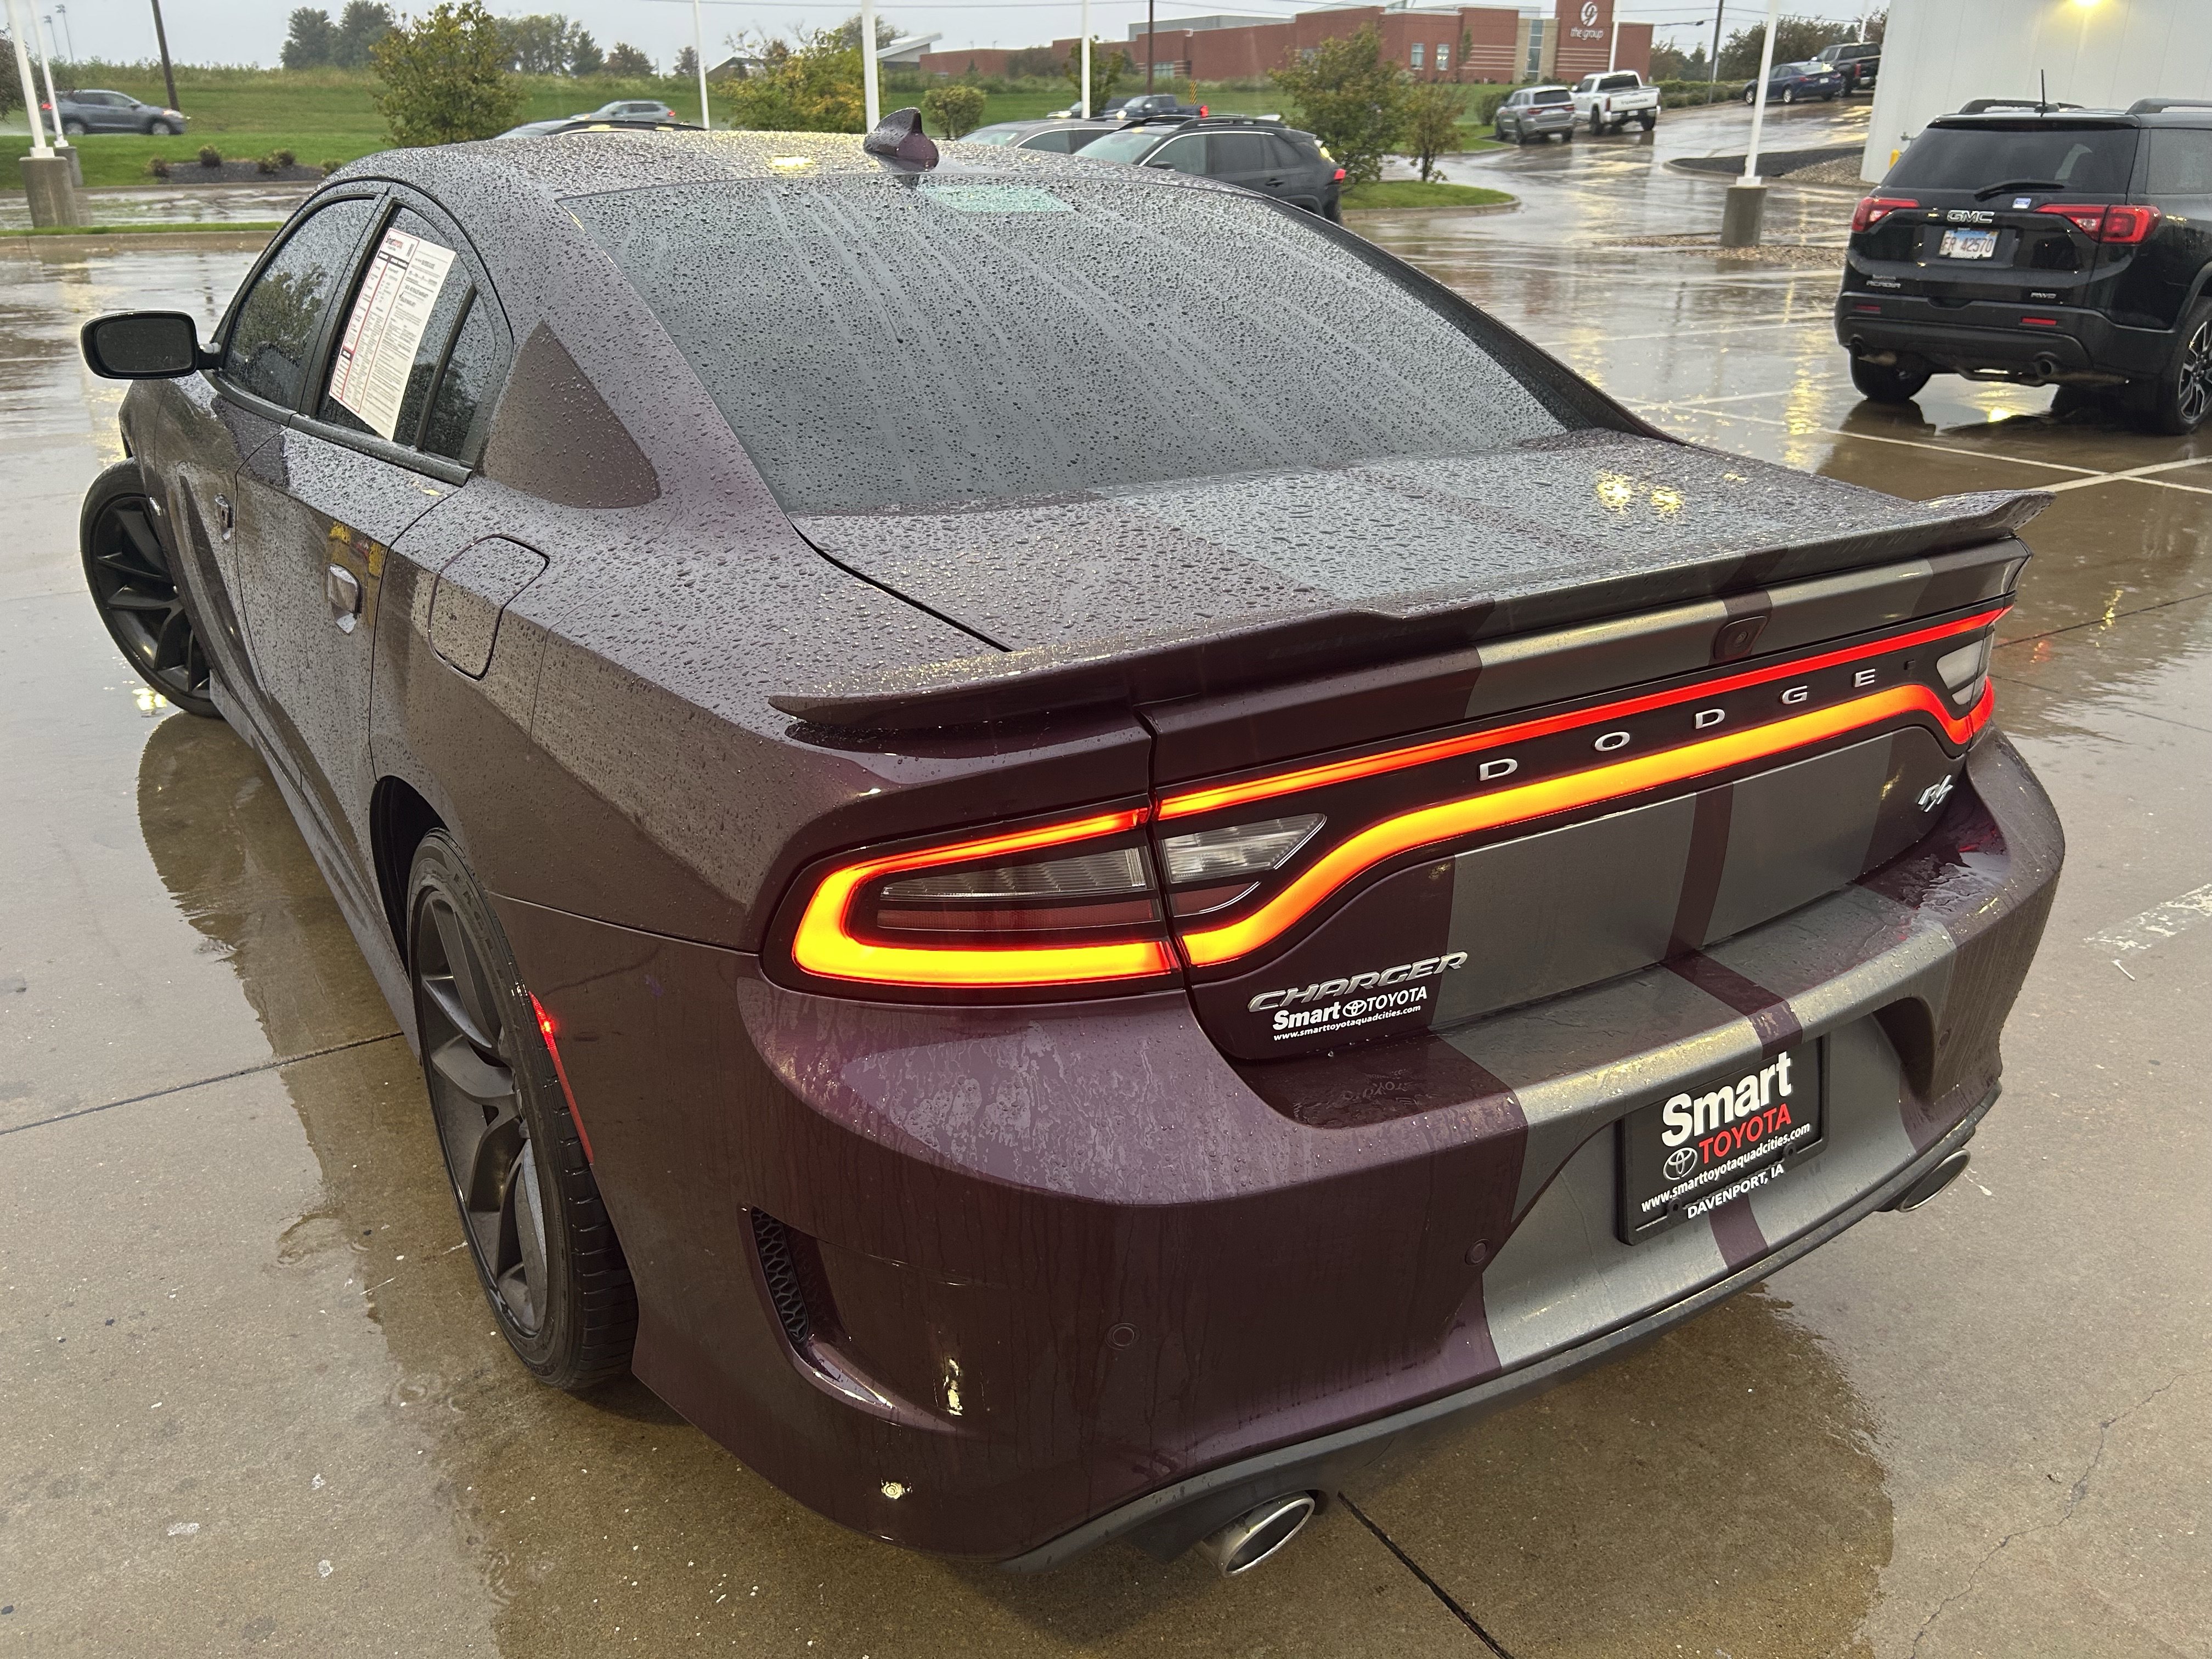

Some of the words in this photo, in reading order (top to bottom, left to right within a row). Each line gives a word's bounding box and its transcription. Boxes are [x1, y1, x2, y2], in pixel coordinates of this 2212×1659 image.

[1582, 30, 1604, 41] group
[1947, 210, 1995, 223] GMC
[1960, 238, 1994, 253] 42570
[1479, 668, 1876, 782] DODGE
[1247, 951, 1468, 1013] CHARGER
[1273, 1001, 1341, 1030] Smart
[1366, 986, 1427, 1012] TOYOTA
[1273, 1004, 1421, 1041] www.smarttoyotaquadcities.com
[1661, 1051, 1792, 1147] Smart
[1698, 1103, 1792, 1164] TOYOTA
[1641, 1123, 1810, 1212] www.smarttoyotaquadcities.com
[1687, 1171, 1768, 1219] DAVENPORT,
[1770, 1164, 1784, 1180] IA
